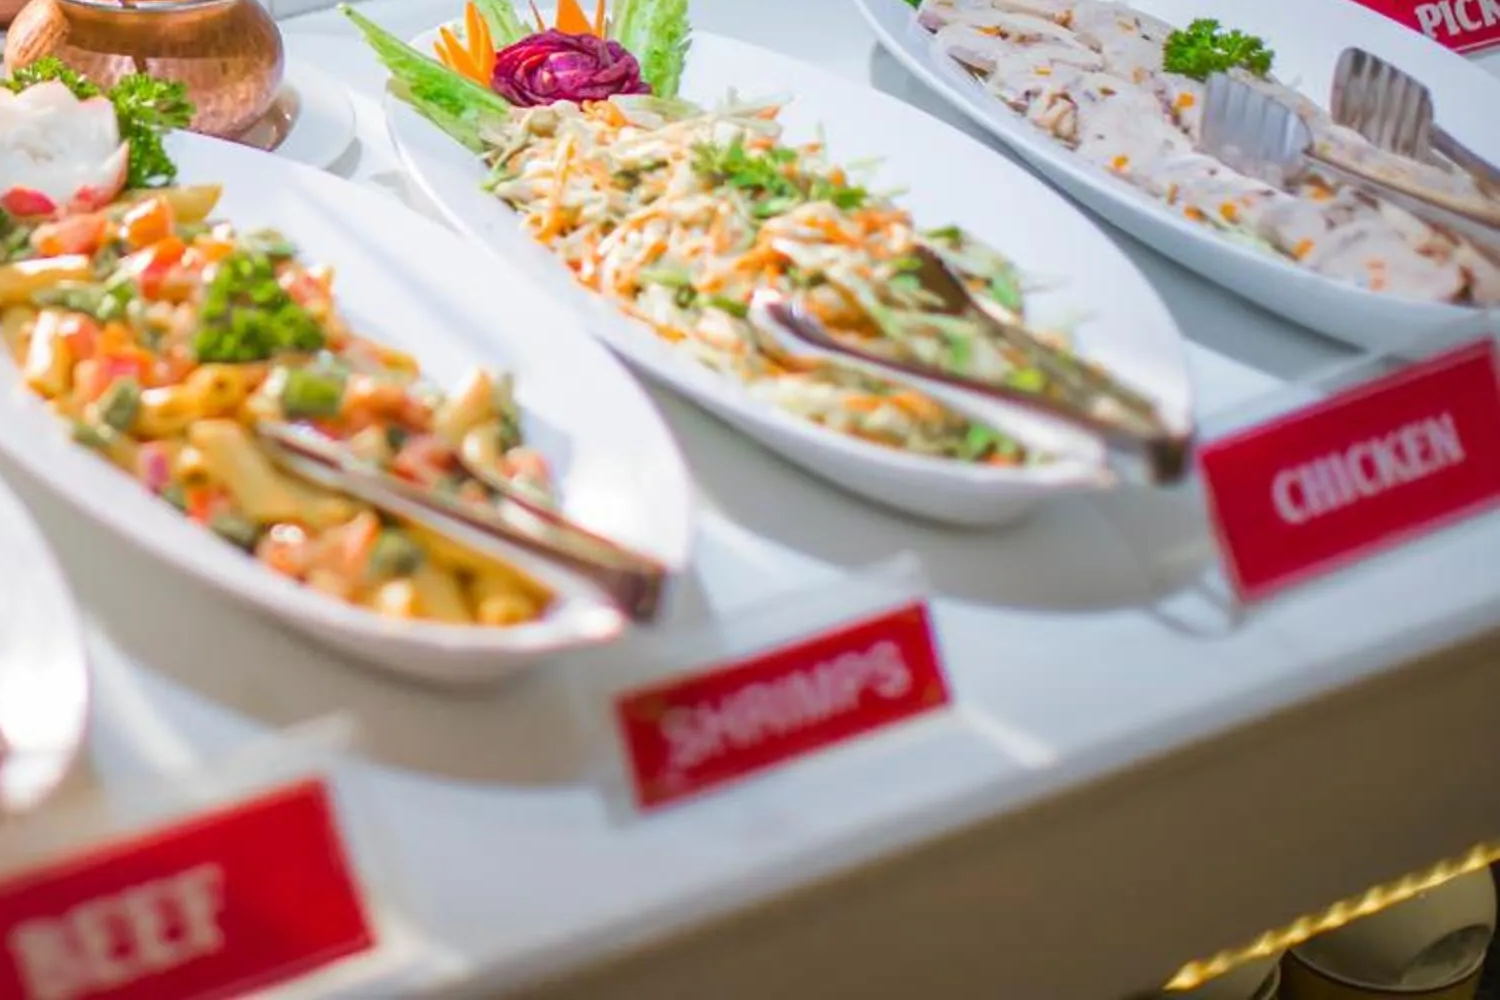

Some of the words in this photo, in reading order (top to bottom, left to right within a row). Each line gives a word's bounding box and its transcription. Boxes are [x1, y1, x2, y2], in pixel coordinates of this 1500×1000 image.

[1271, 411, 1466, 524] CHICKEN
[660, 641, 911, 767] SHRIMPS
[10, 861, 225, 1000] BEEF
